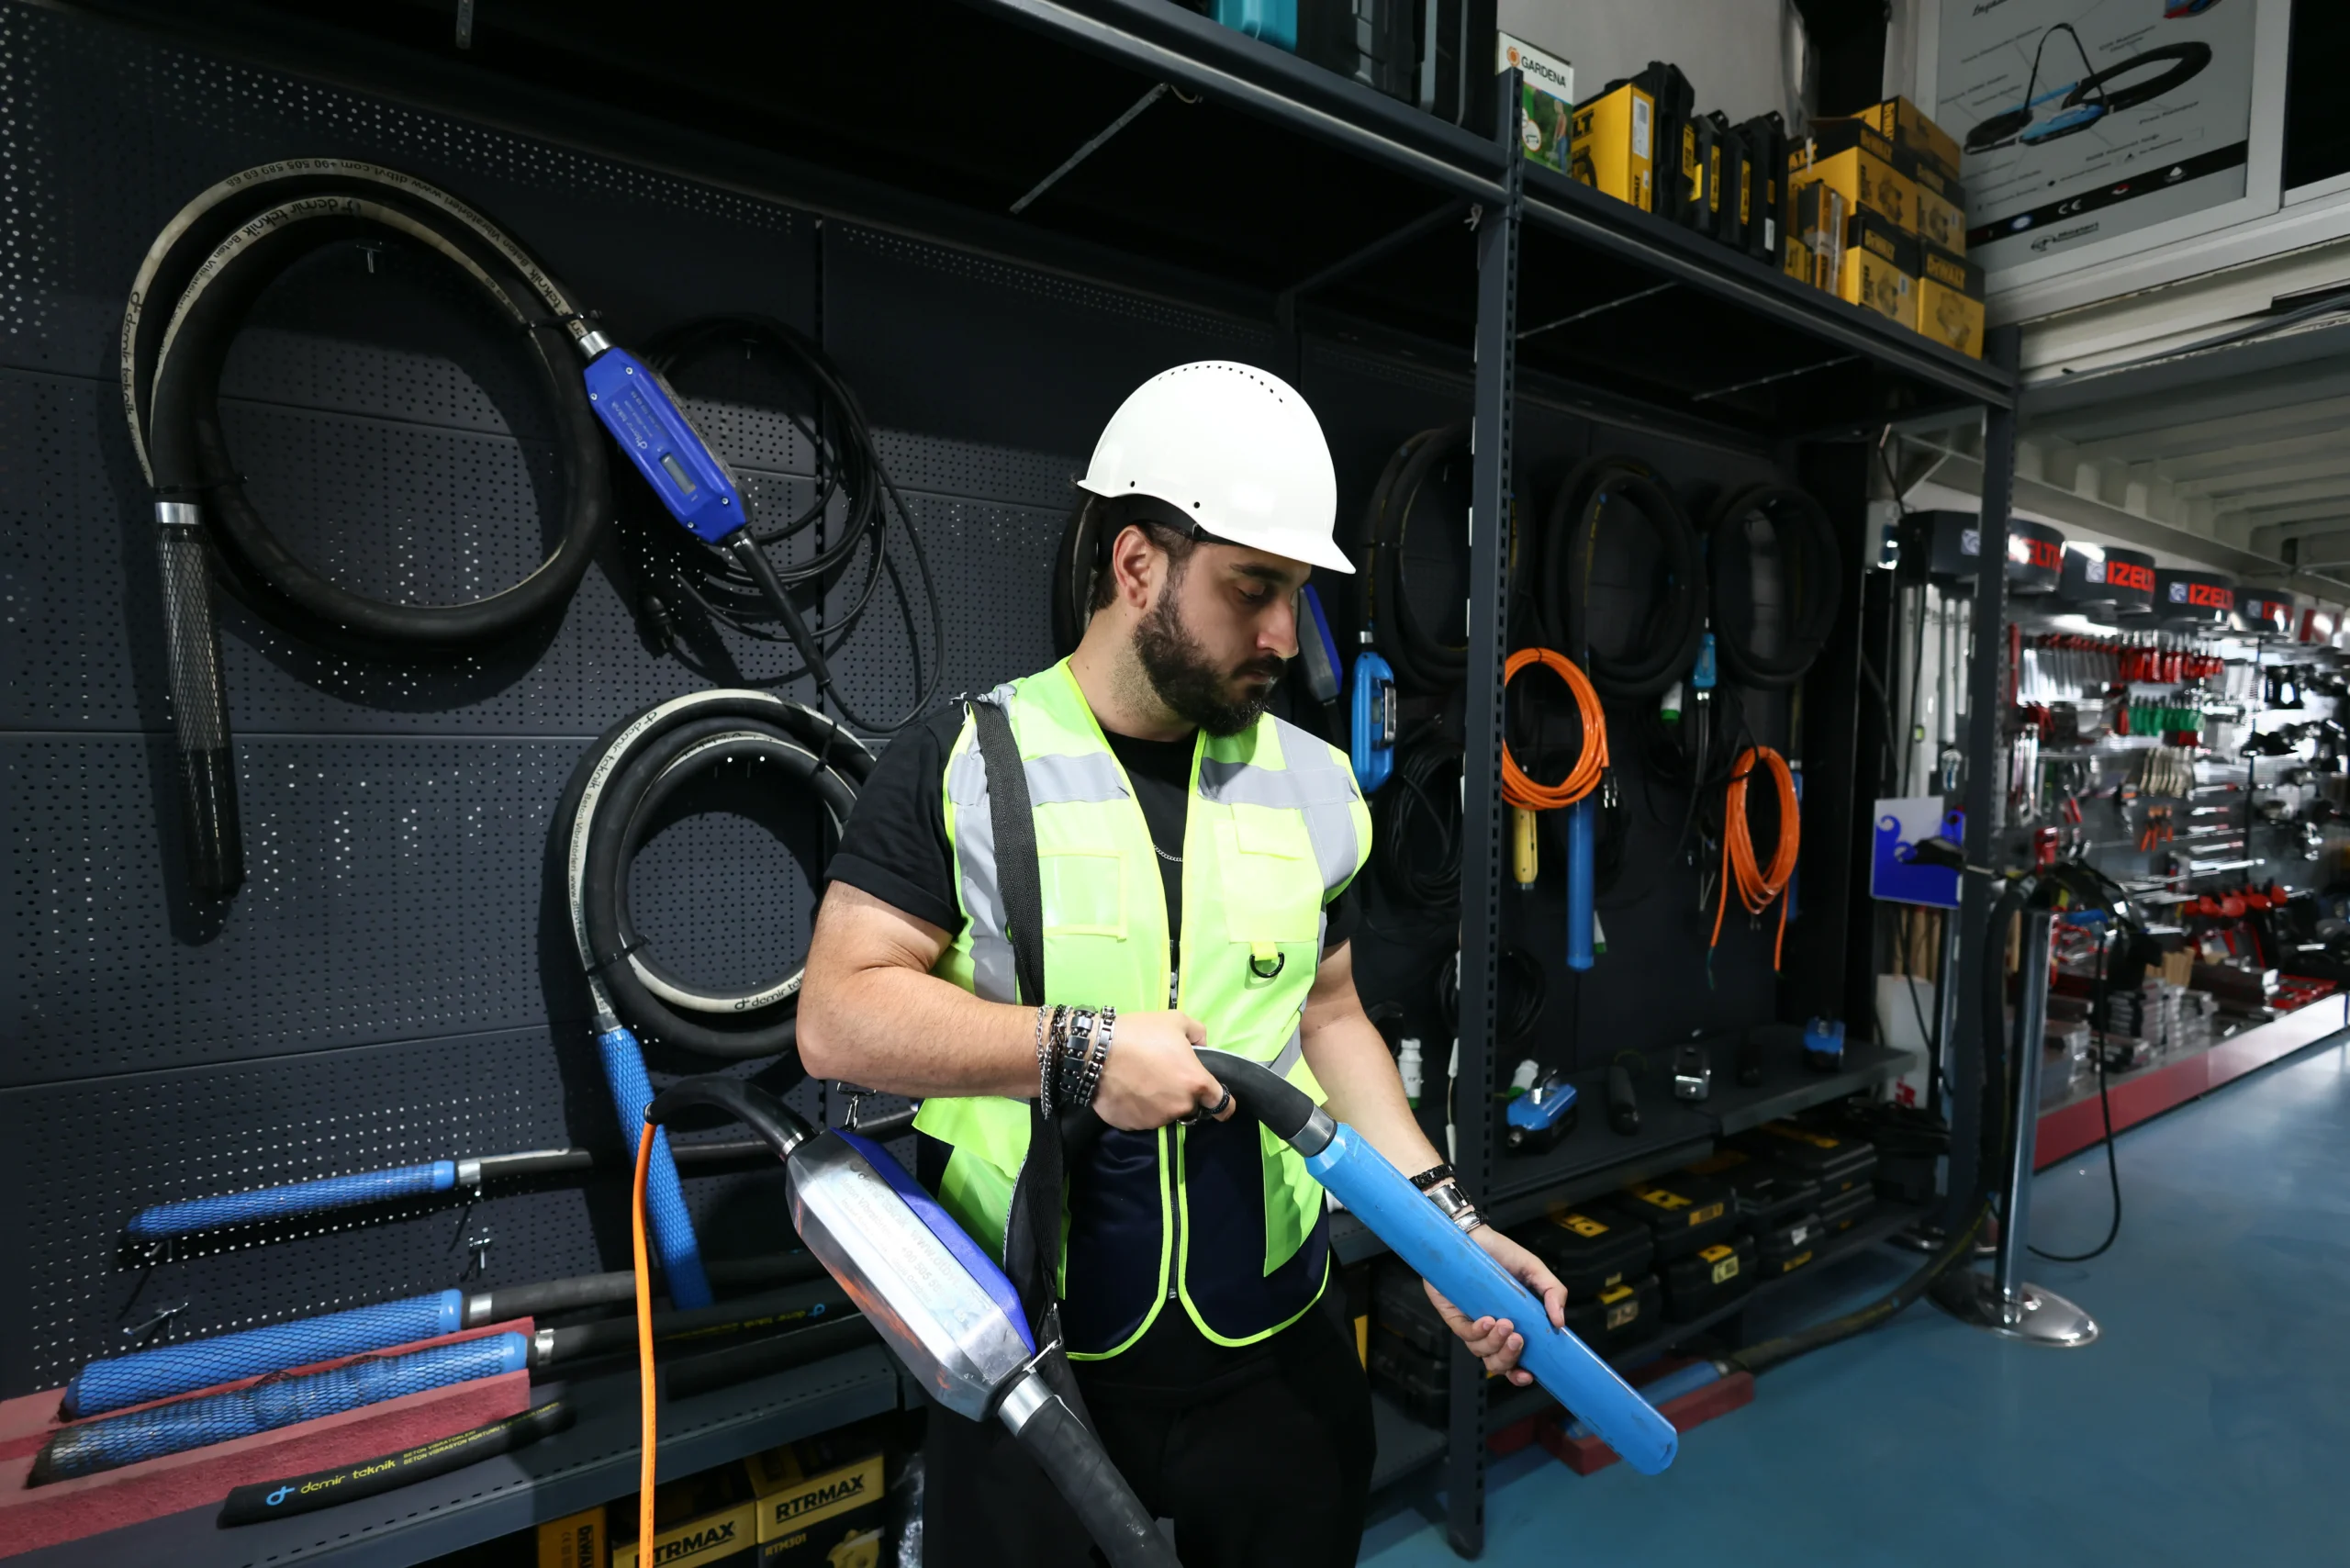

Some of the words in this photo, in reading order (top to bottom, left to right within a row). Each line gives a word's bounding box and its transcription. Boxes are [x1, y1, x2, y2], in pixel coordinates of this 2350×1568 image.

[1521, 55, 1567, 89] GARDENA
[243, 168, 260, 181] 69
[261, 162, 285, 176] 589
[286, 160, 310, 171] 505
[313, 159, 337, 170] +90
[225, 175, 242, 188] 68
[289, 197, 340, 215] demir
[241, 207, 290, 238] teknik
[212, 233, 242, 259] Beton
[501, 239, 531, 268] Beton
[529, 266, 563, 309] teknik
[121, 312, 138, 364] demir
[121, 366, 135, 416] teknik
[611, 721, 643, 754] demir
[588, 754, 616, 790] teknik
[576, 792, 593, 820] Beton
[751, 987, 787, 1008] demir
[403, 1447, 427, 1460] BETON
[403, 1453, 428, 1466] BETON
[300, 1474, 346, 1495] demir
[352, 1459, 397, 1480] teknik
[775, 1473, 865, 1522] RTRMAX
[634, 1520, 736, 1568] TRMAX
